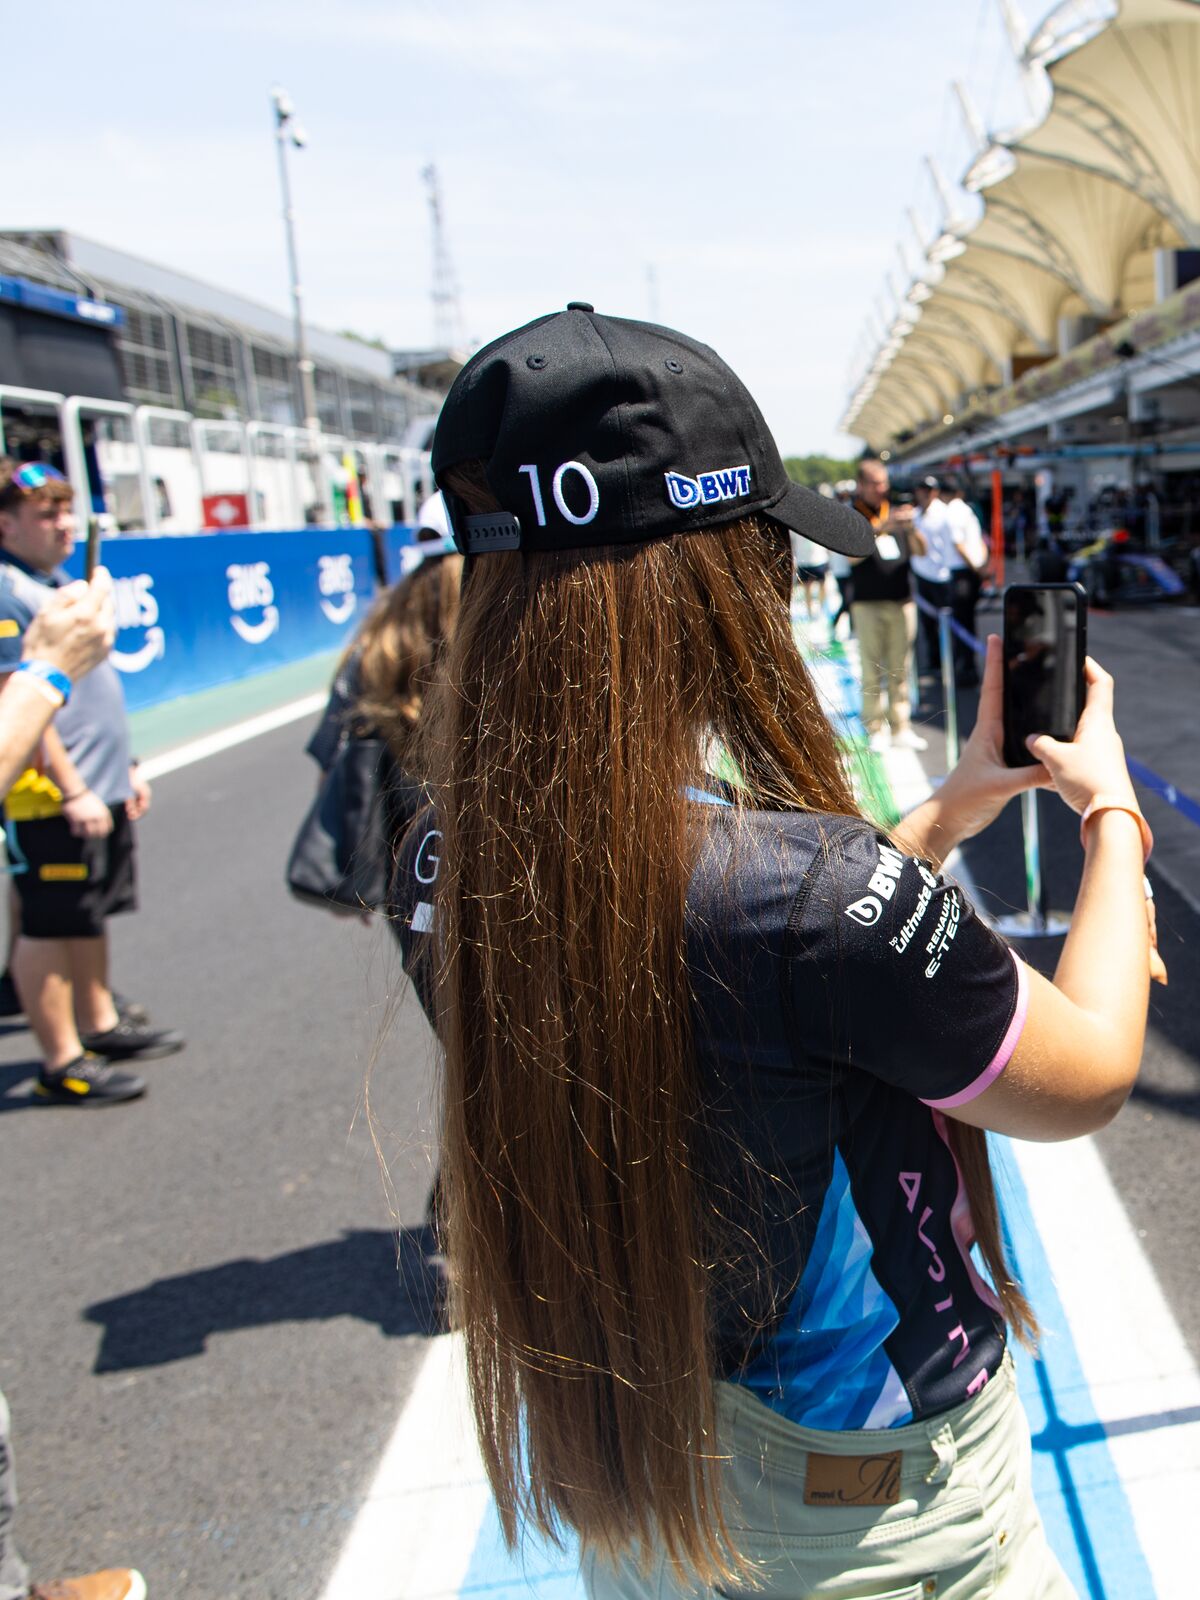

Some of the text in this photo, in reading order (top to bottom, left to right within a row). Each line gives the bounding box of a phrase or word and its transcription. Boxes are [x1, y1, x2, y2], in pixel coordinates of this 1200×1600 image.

[518, 461, 600, 528] 10
[698, 466, 751, 505] BWT
[926, 892, 951, 954] RENAULT
